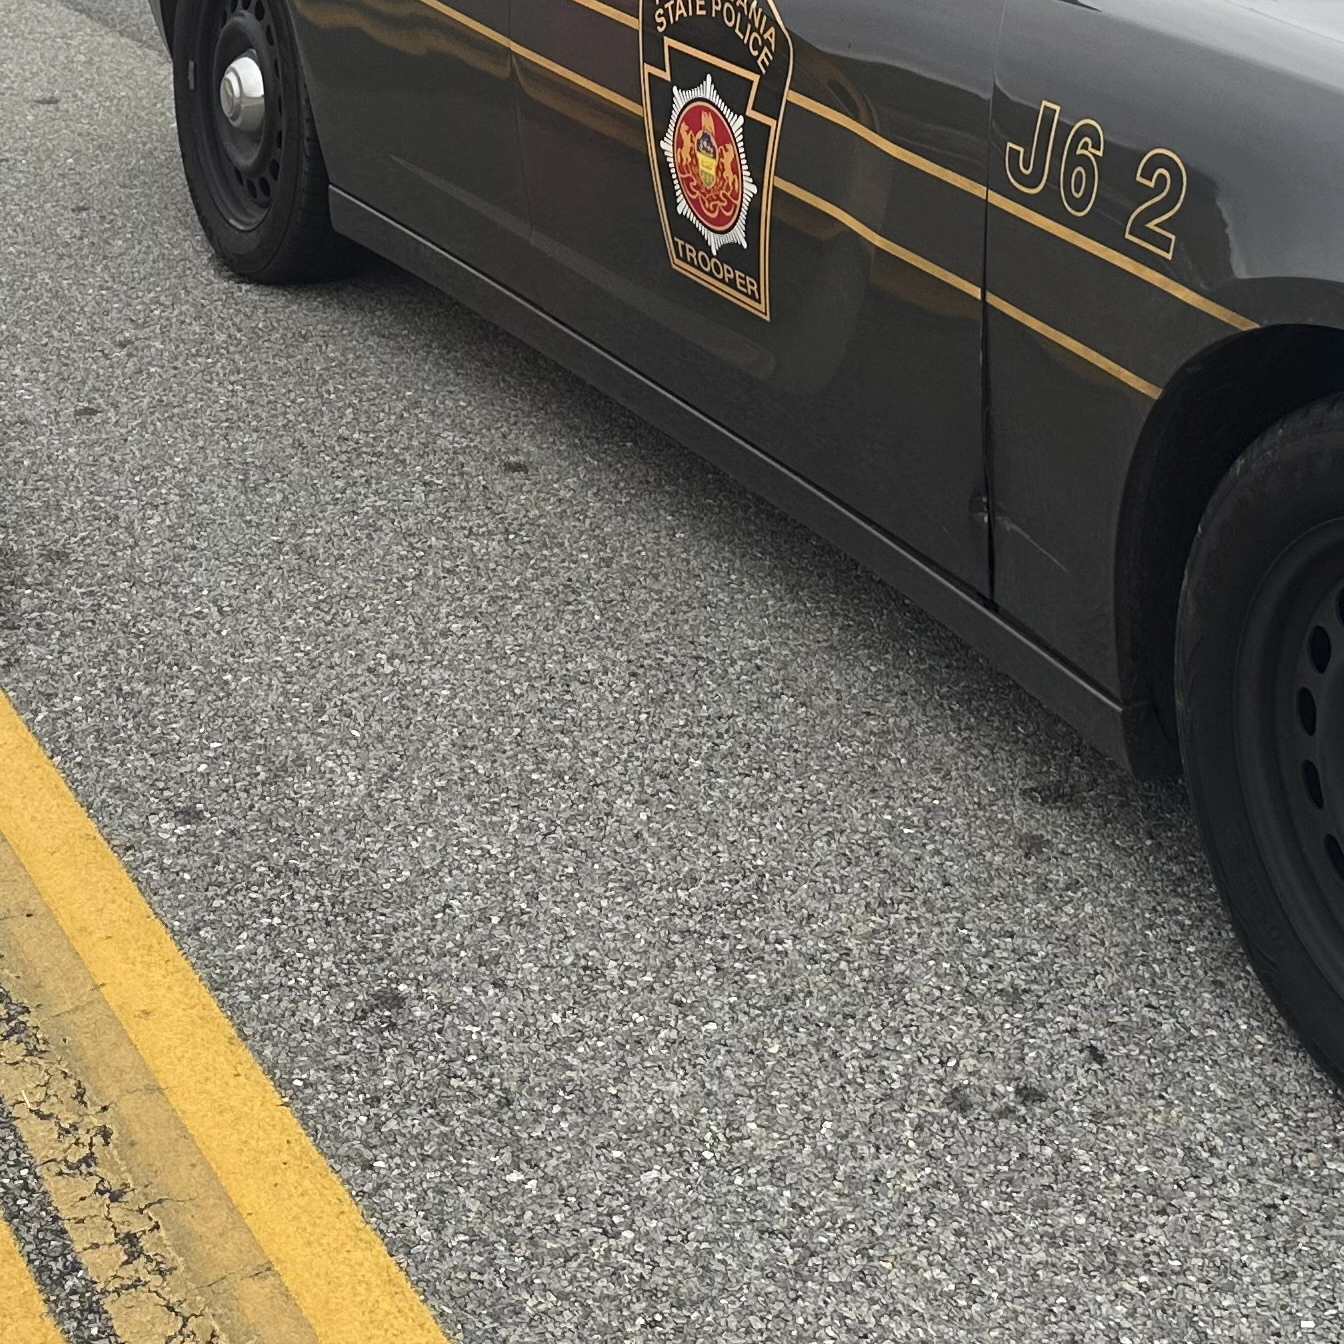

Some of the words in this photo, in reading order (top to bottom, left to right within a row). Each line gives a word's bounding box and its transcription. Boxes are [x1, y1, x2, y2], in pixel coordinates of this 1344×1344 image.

[1005, 99, 1105, 218] J6
[1124, 147, 1188, 261] 2
[674, 236, 760, 299] TROOPER
